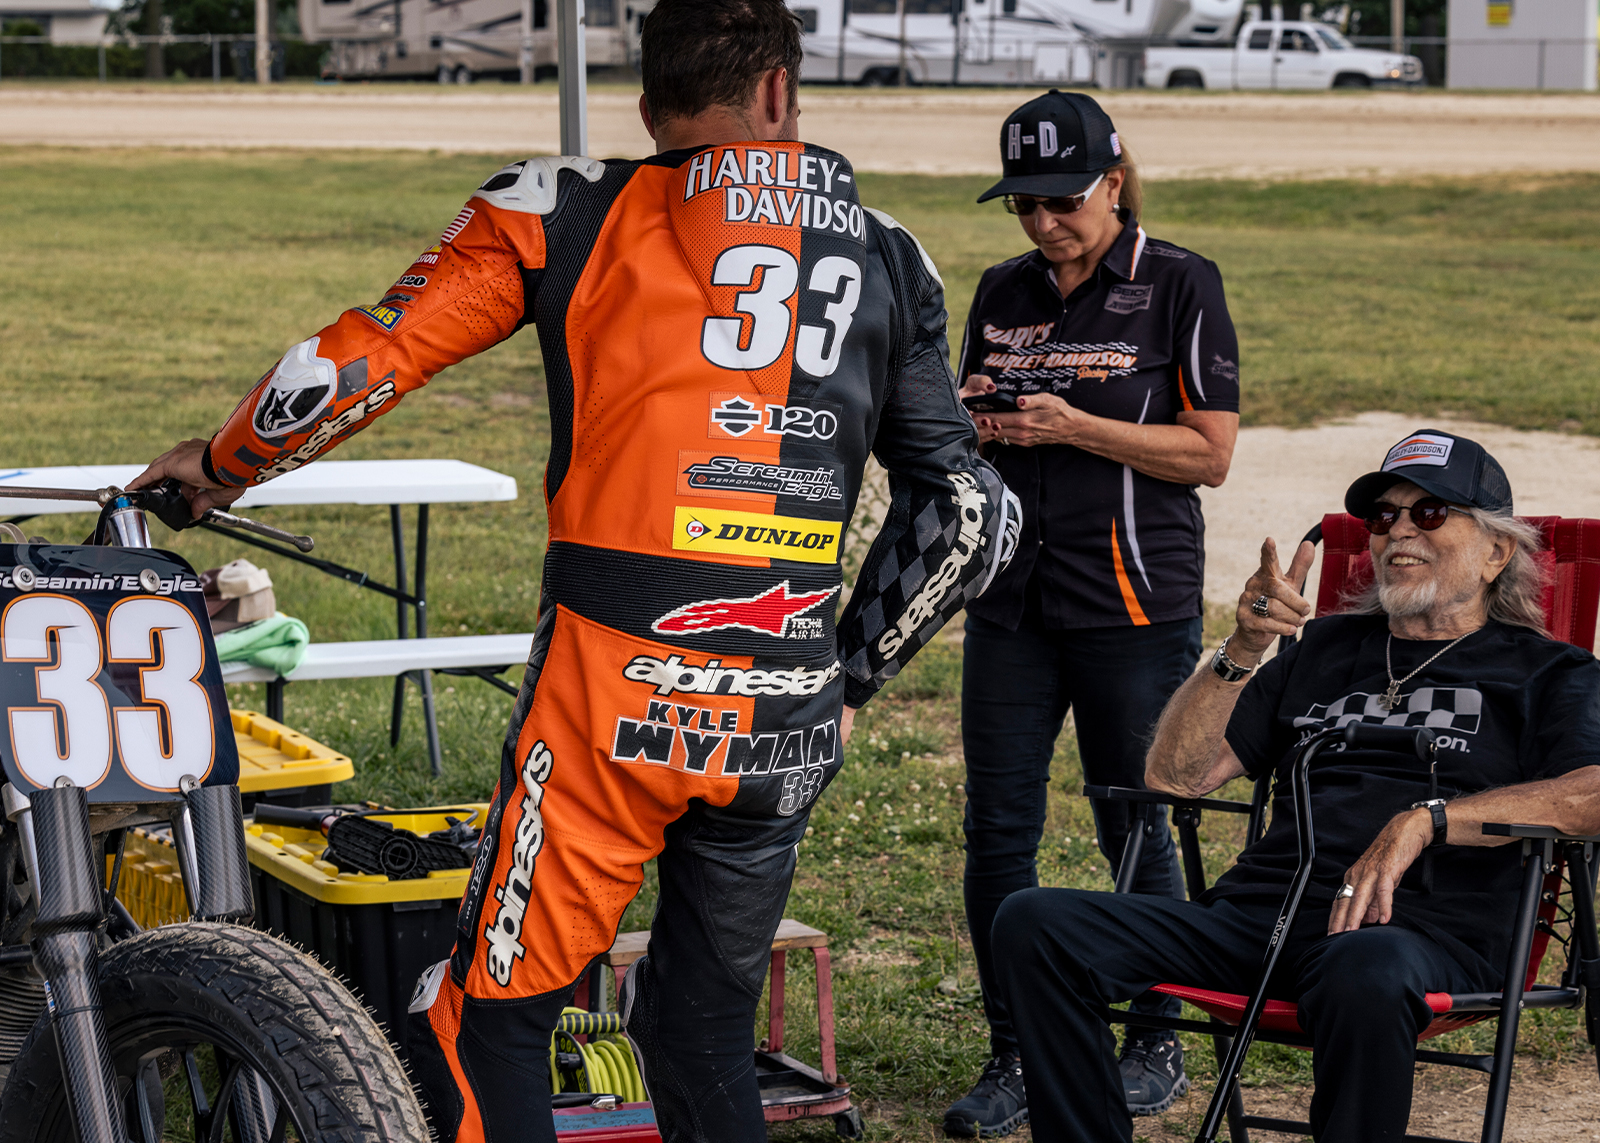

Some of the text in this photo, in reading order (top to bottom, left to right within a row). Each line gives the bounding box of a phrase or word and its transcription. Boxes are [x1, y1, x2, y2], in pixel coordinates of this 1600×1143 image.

[1008, 121, 1058, 160] H-D
[684, 148, 851, 203] HARLEY-
[397, 275, 427, 287] 120
[700, 243, 862, 378] 33
[1021, 380, 1041, 391] New
[1051, 379, 1073, 393] York
[1076, 365, 1110, 382] Racing
[764, 404, 838, 441] 120
[684, 456, 835, 484] Screamin'
[709, 477, 779, 489] PERFORMANCE
[778, 480, 843, 501] Eagle
[714, 523, 835, 550] DUNLOP
[874, 470, 992, 662] alpinestars
[120, 575, 203, 596] Egle
[1, 592, 216, 793] 33
[622, 654, 842, 696] alpinestars
[646, 698, 739, 734] KYLE
[611, 716, 837, 776] WYMAN
[776, 766, 824, 817] 33
